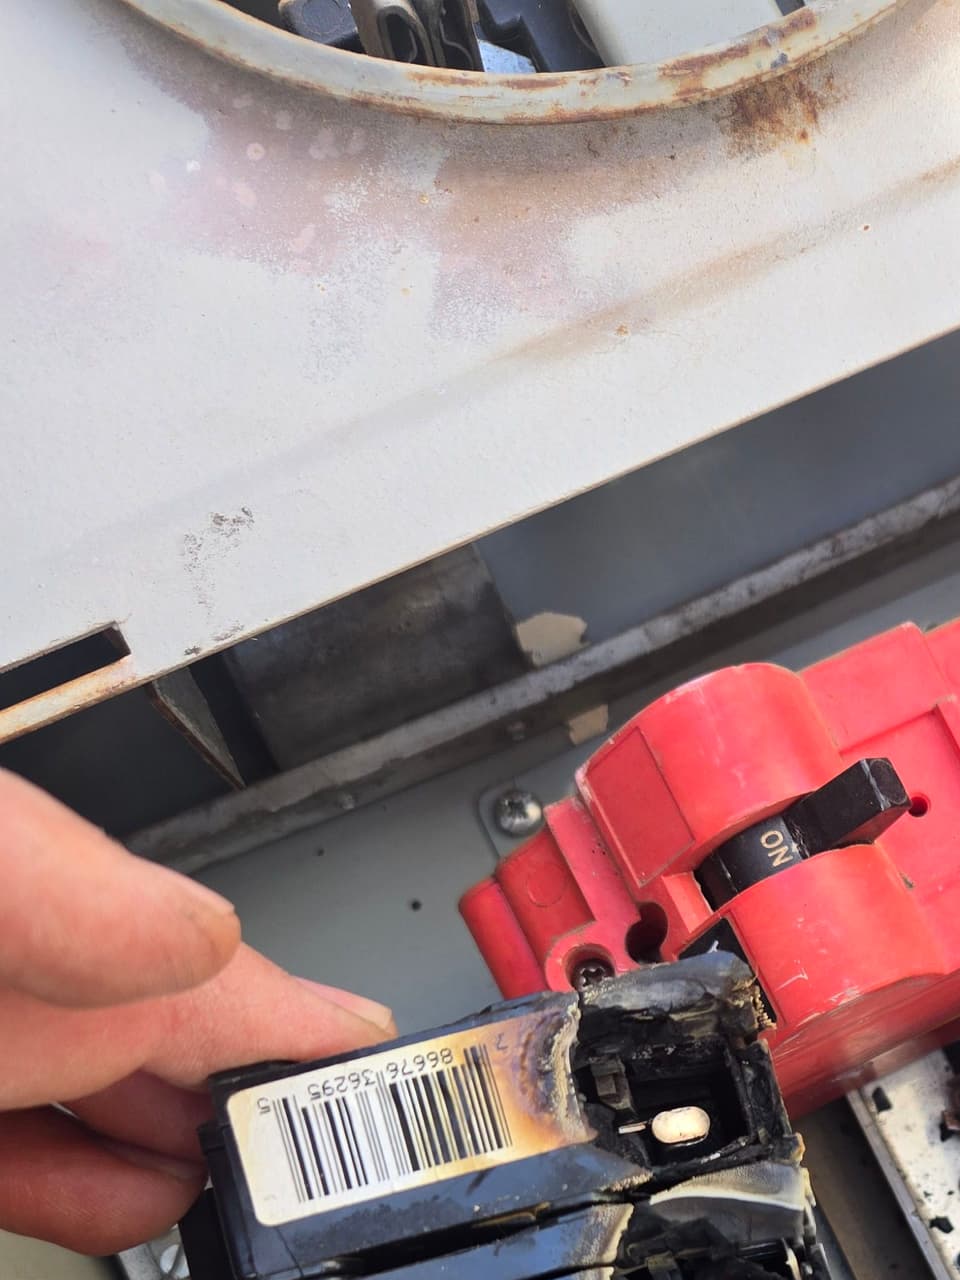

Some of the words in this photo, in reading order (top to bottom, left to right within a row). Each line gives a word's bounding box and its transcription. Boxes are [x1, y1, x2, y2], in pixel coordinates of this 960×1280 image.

[759, 830, 796, 867] ON
[384, 1044, 454, 1081] 86676
[306, 1065, 376, 1103] 36295
[255, 1096, 271, 1114] 5
